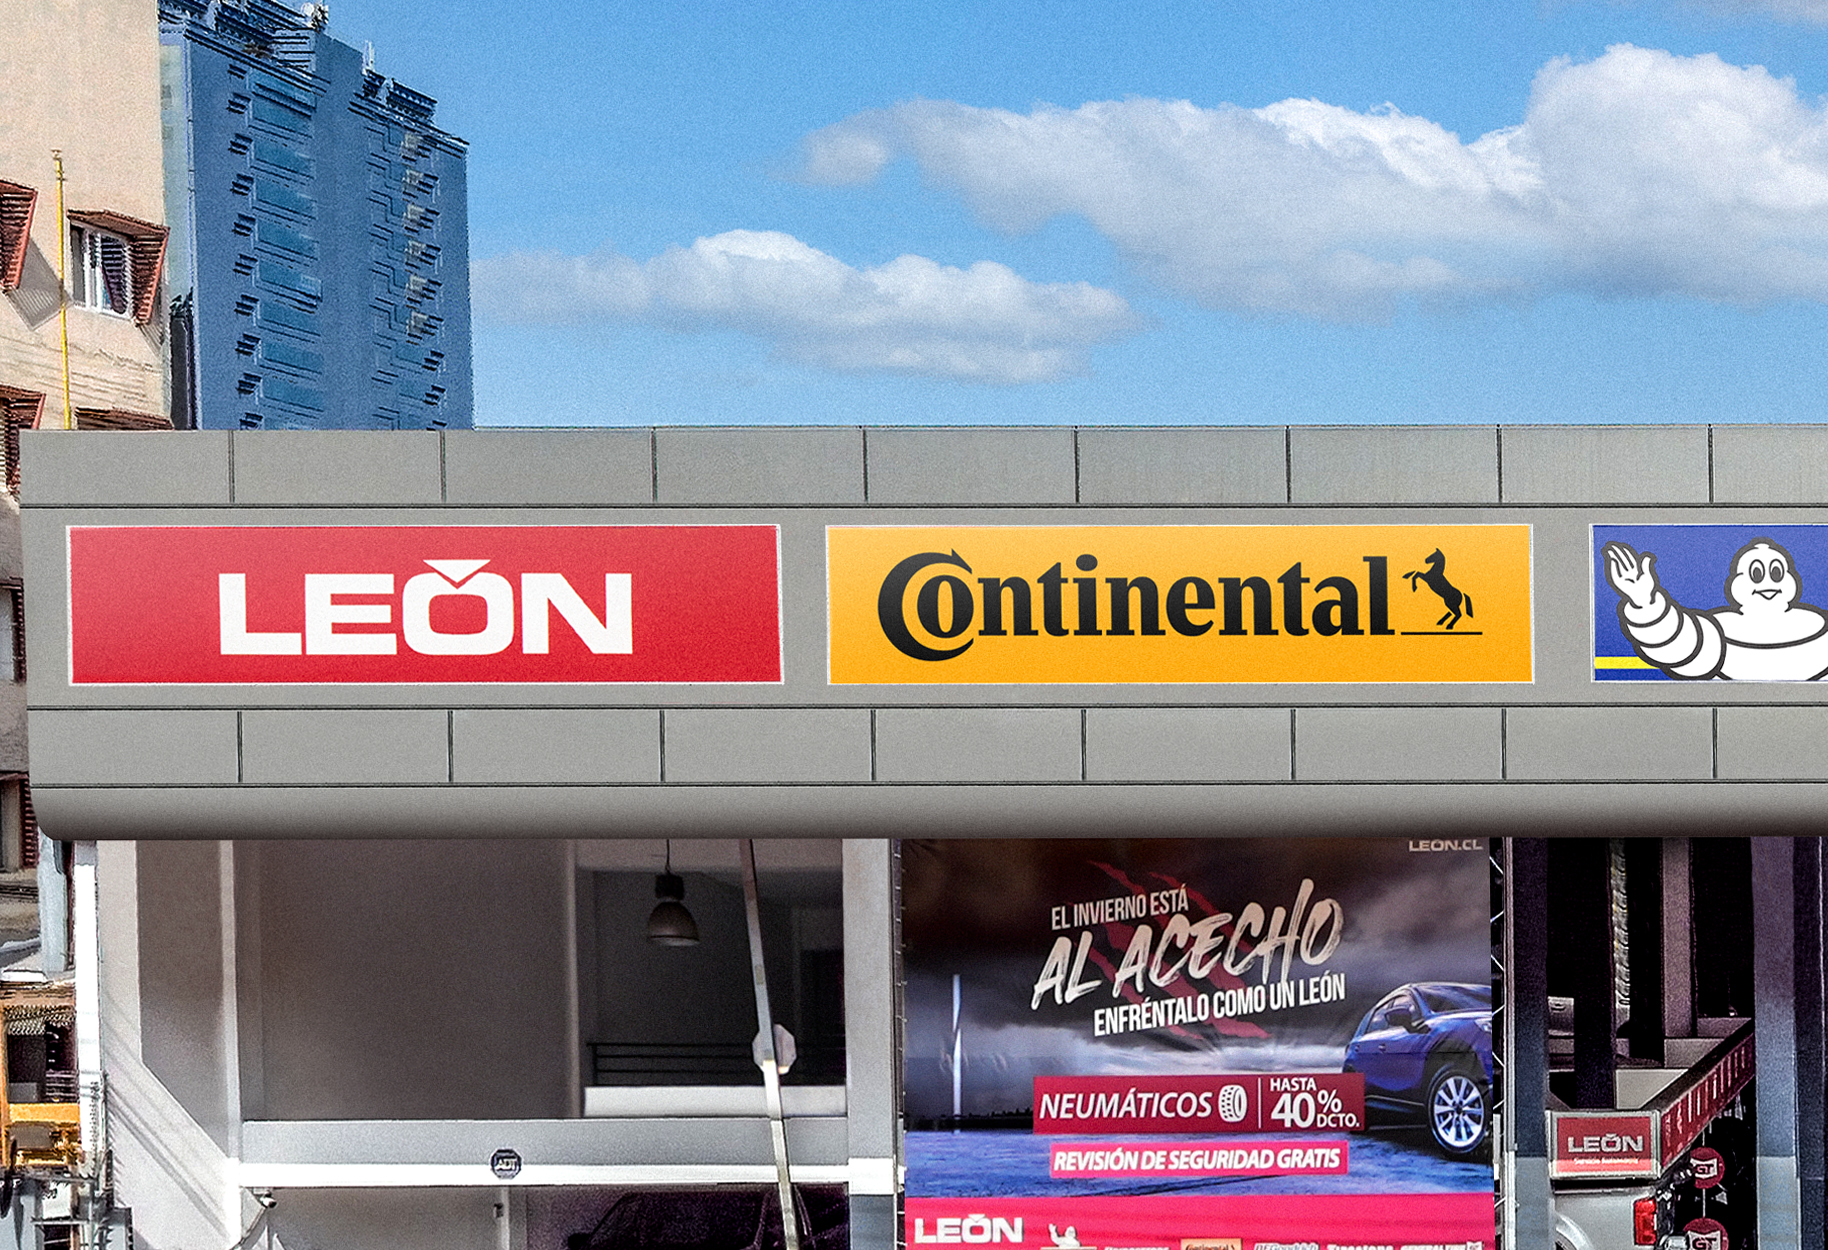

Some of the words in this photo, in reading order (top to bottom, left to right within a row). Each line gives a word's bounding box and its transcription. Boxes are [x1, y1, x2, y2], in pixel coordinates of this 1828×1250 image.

[878, 549, 1395, 662] Continental
[1052, 906, 1070, 931] EL
[1074, 894, 1147, 928] INVIERNO
[1149, 883, 1189, 916] ESTÁ
[1030, 930, 1102, 1010] AL
[1112, 878, 1345, 998] ACECHO
[1094, 993, 1210, 1037] ENFRÉNTALO
[1213, 985, 1266, 1018] COMO
[1270, 981, 1296, 1010] UN
[1299, 970, 1346, 1006] LEÓN
[1039, 1087, 1213, 1120] NEUMÁTICOS
[1270, 1077, 1317, 1092] HASTA
[1317, 1113, 1360, 1128] DCTO.
[1054, 1147, 1139, 1171] REVISIÓN
[1141, 1151, 1166, 1170] DE
[1168, 1149, 1275, 1170] SEGURIDAD
[1277, 1147, 1341, 1169] GRATIS
